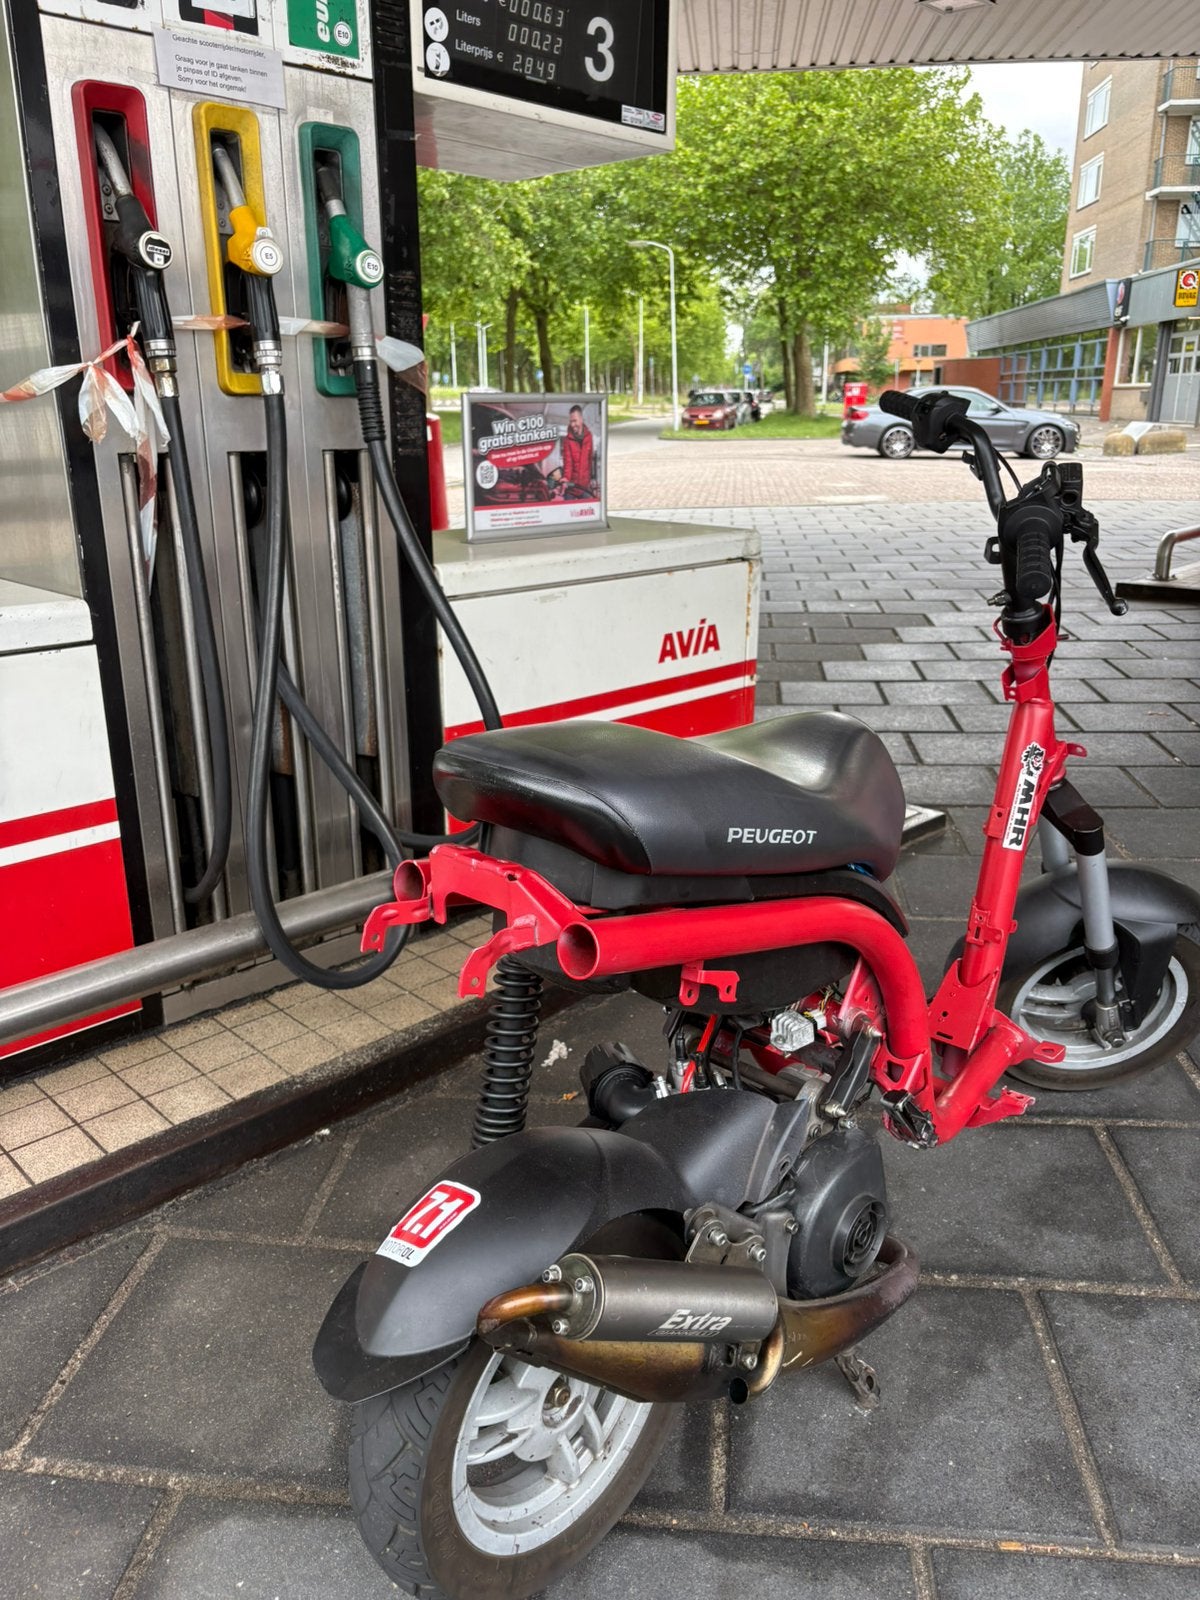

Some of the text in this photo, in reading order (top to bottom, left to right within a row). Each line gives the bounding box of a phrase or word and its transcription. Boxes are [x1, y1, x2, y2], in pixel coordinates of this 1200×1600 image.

[456, 9, 481, 27] Liters
[172, 34, 198, 45] Geachte
[337, 30, 348, 39] E10
[455, 39, 494, 60] Literprijs
[497, 52, 504, 62] €
[585, 16, 615, 82] 3
[175, 54, 268, 78] Graag voor je gaat tanken binnen
[176, 65, 182, 73] je
[183, 67, 203, 76] pinpas
[177, 75, 246, 93] Sorry voor het ongemak!
[265, 252, 274, 260] E5
[367, 262, 379, 272] E10
[493, 416, 544, 434] Win €100
[480, 433, 513, 453] gratis
[516, 427, 557, 443] tanken!
[1009, 779, 1035, 846] MHR
[727, 827, 817, 845] PEUGEOT
[659, 1308, 733, 1331] Extra
